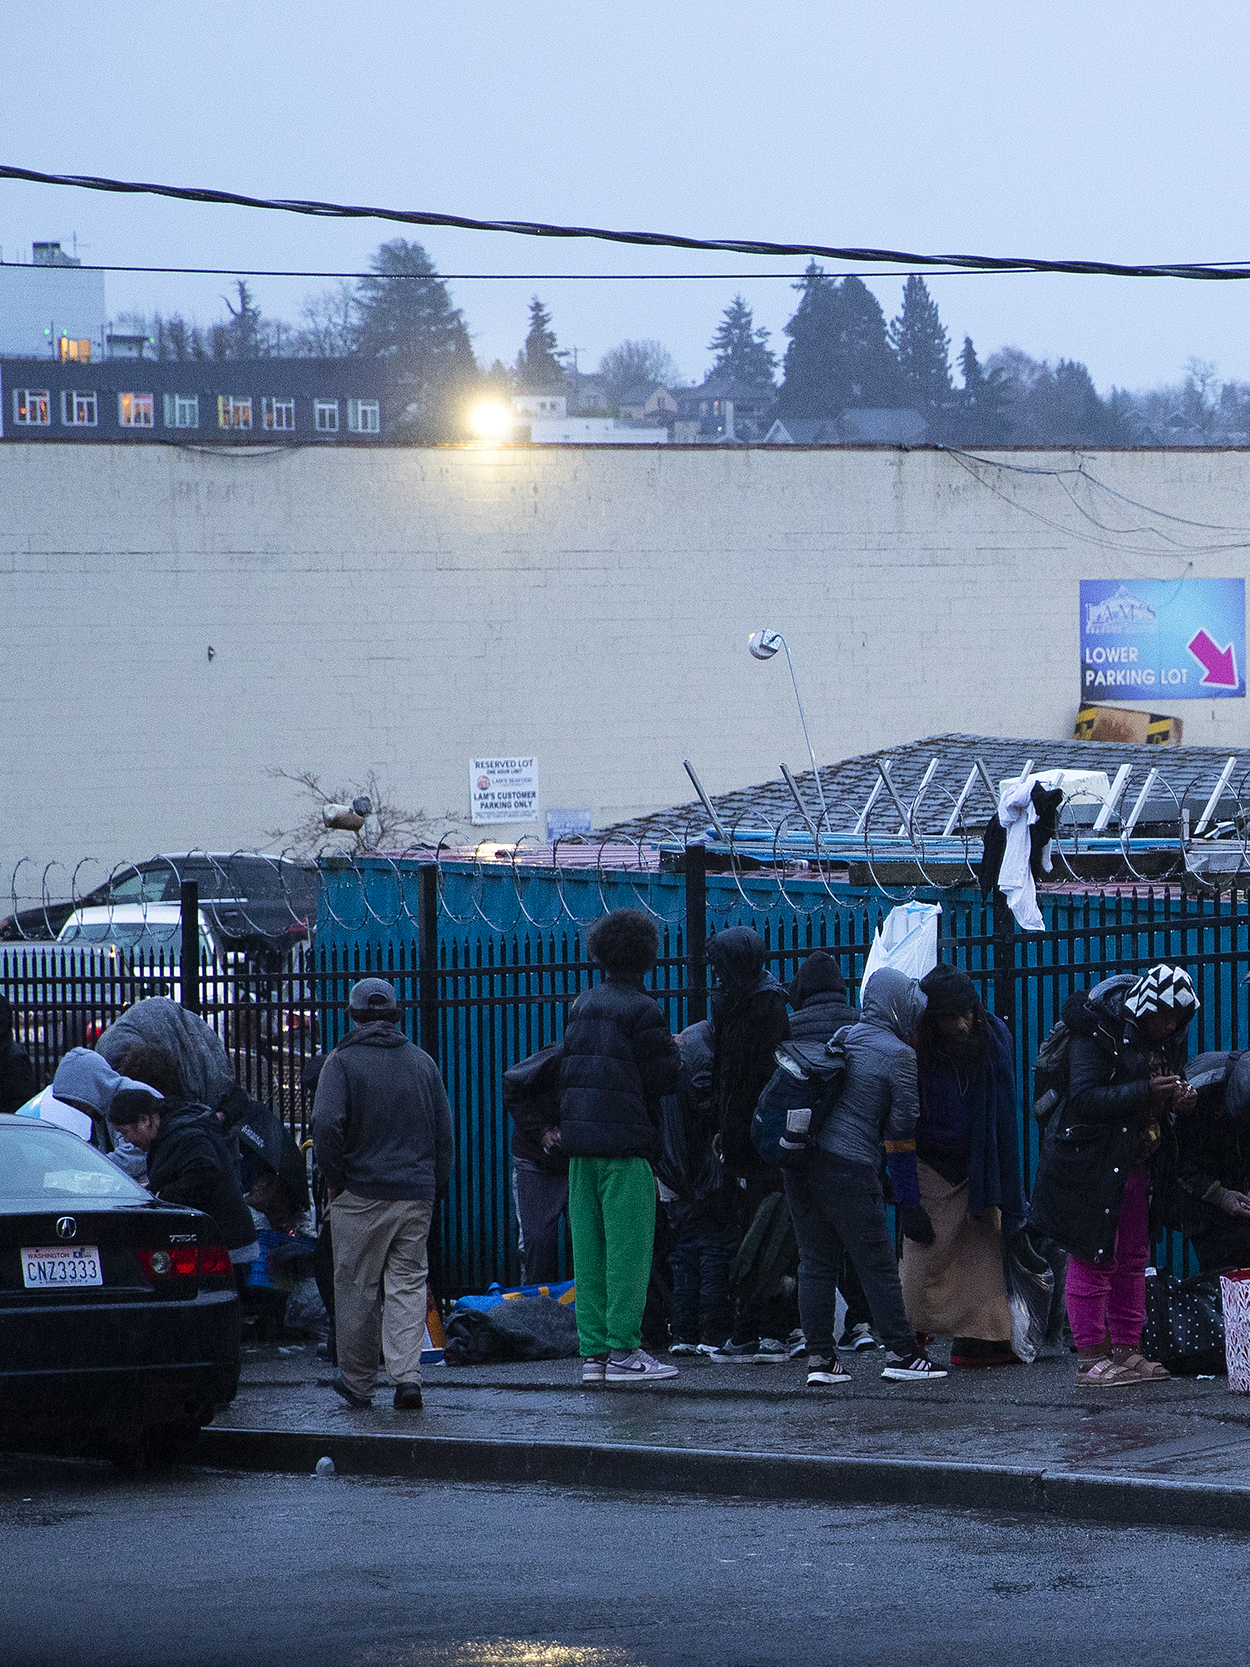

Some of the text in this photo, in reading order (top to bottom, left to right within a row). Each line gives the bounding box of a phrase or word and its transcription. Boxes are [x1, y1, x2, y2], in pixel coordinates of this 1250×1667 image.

[1085, 647, 1138, 663] LOWER
[1085, 668, 1188, 686] PARKING LOT
[475, 759, 533, 768] RESERVED LOT
[497, 791, 536, 799] CUSTOMER
[27, 1252, 70, 1260] WASHINGTON
[27, 1260, 98, 1281] CNZ3333
